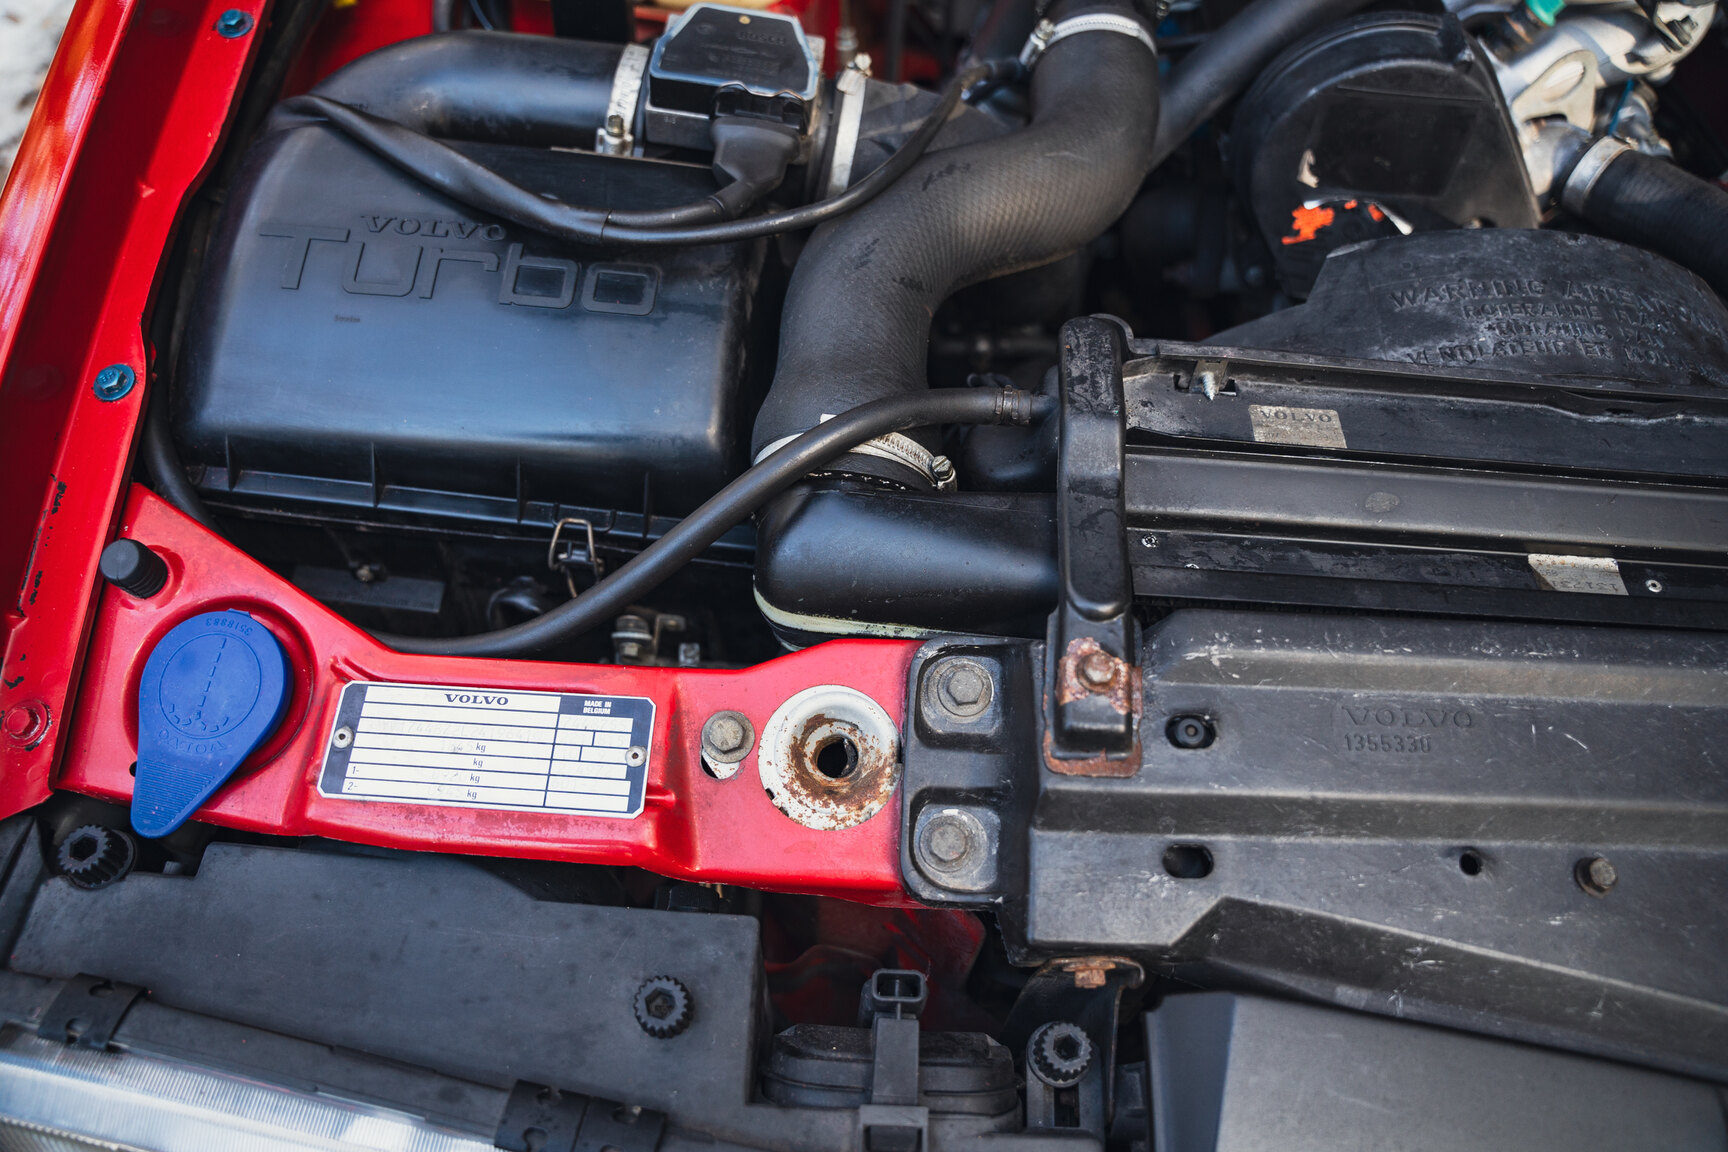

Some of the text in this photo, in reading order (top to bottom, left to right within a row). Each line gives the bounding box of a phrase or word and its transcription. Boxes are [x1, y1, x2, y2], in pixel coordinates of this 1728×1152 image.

[360, 215, 506, 241] VOLVO
[1389, 278, 1548, 311] WARNING
[1260, 409, 1332, 423] VOLVO
[445, 693, 509, 706] VOLVO
[583, 707, 611, 715] BELGIUM
[1341, 705, 1474, 729] VOLVO
[475, 742, 487, 753] kg
[1343, 733, 1433, 754] 1355330
[472, 757, 484, 768] kg
[469, 773, 481, 784] kg
[466, 789, 478, 800] kg
